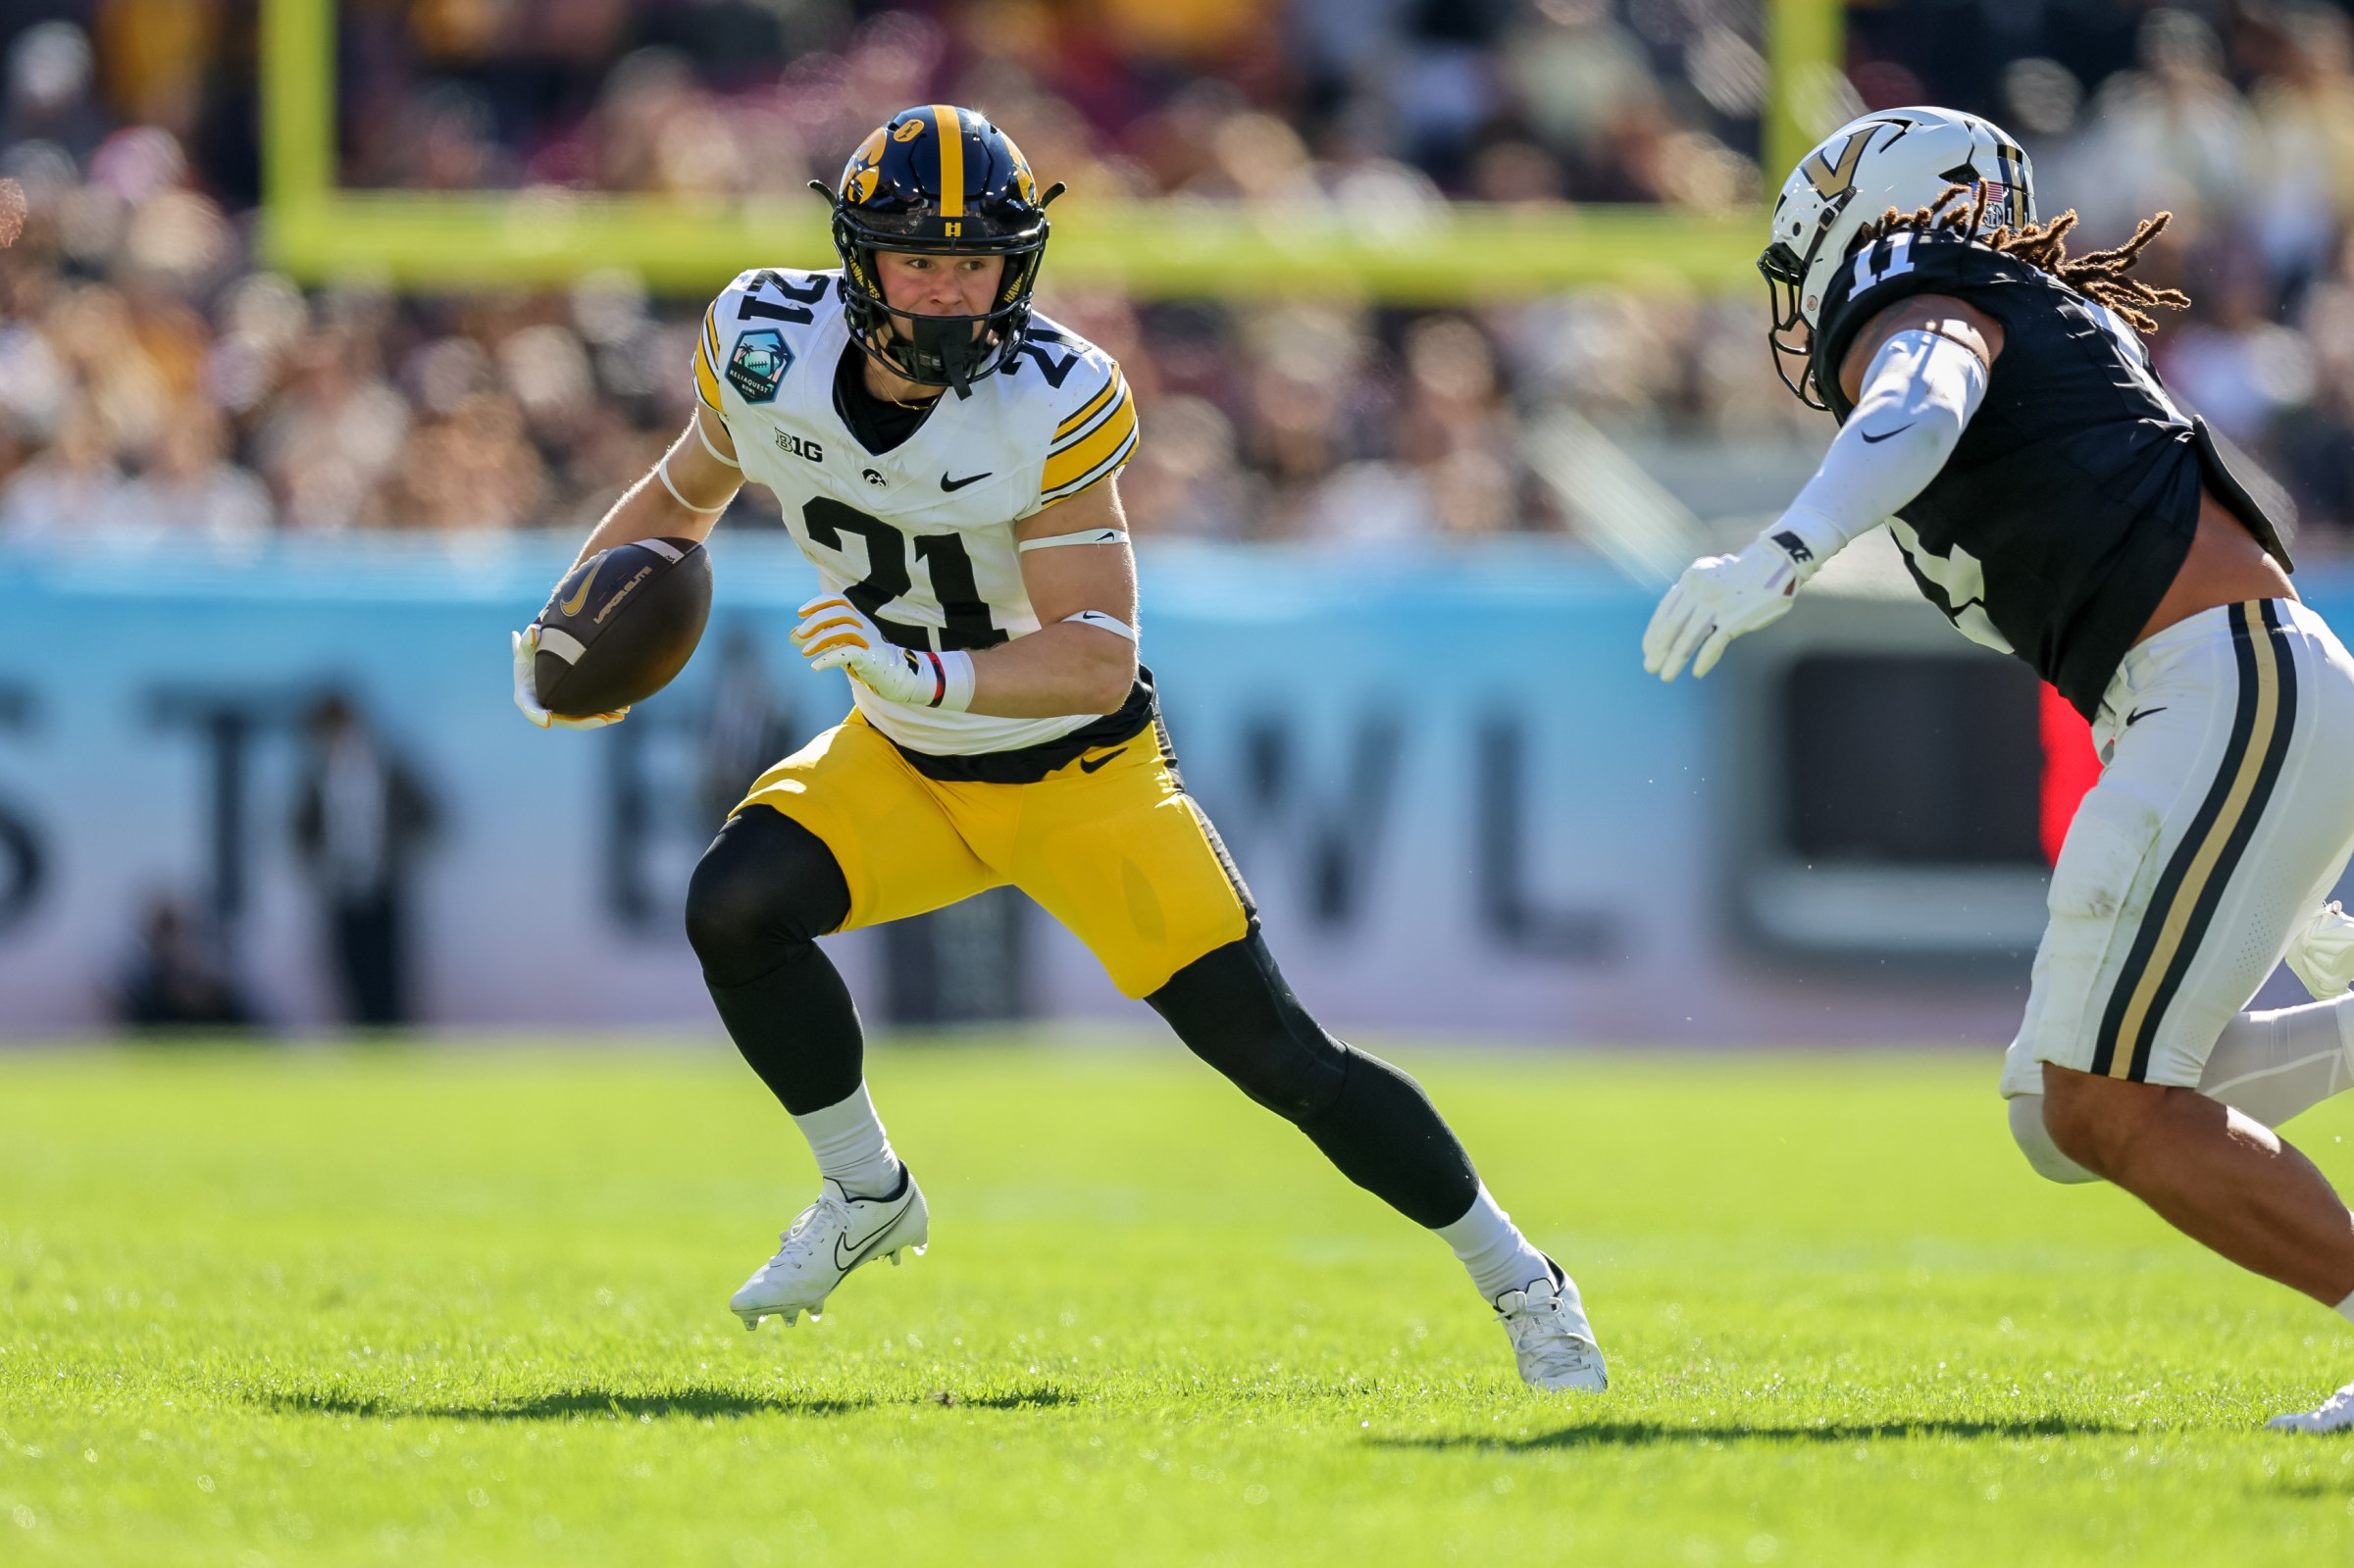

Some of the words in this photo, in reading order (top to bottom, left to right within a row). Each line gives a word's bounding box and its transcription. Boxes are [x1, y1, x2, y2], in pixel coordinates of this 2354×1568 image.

[848, 255, 881, 299] HAWKYES
[1846, 231, 1915, 302] 11
[737, 269, 832, 325] 21
[729, 369, 768, 393] RELIAQUEST
[742, 383, 756, 395] BOWL
[801, 495, 1010, 653] 21
